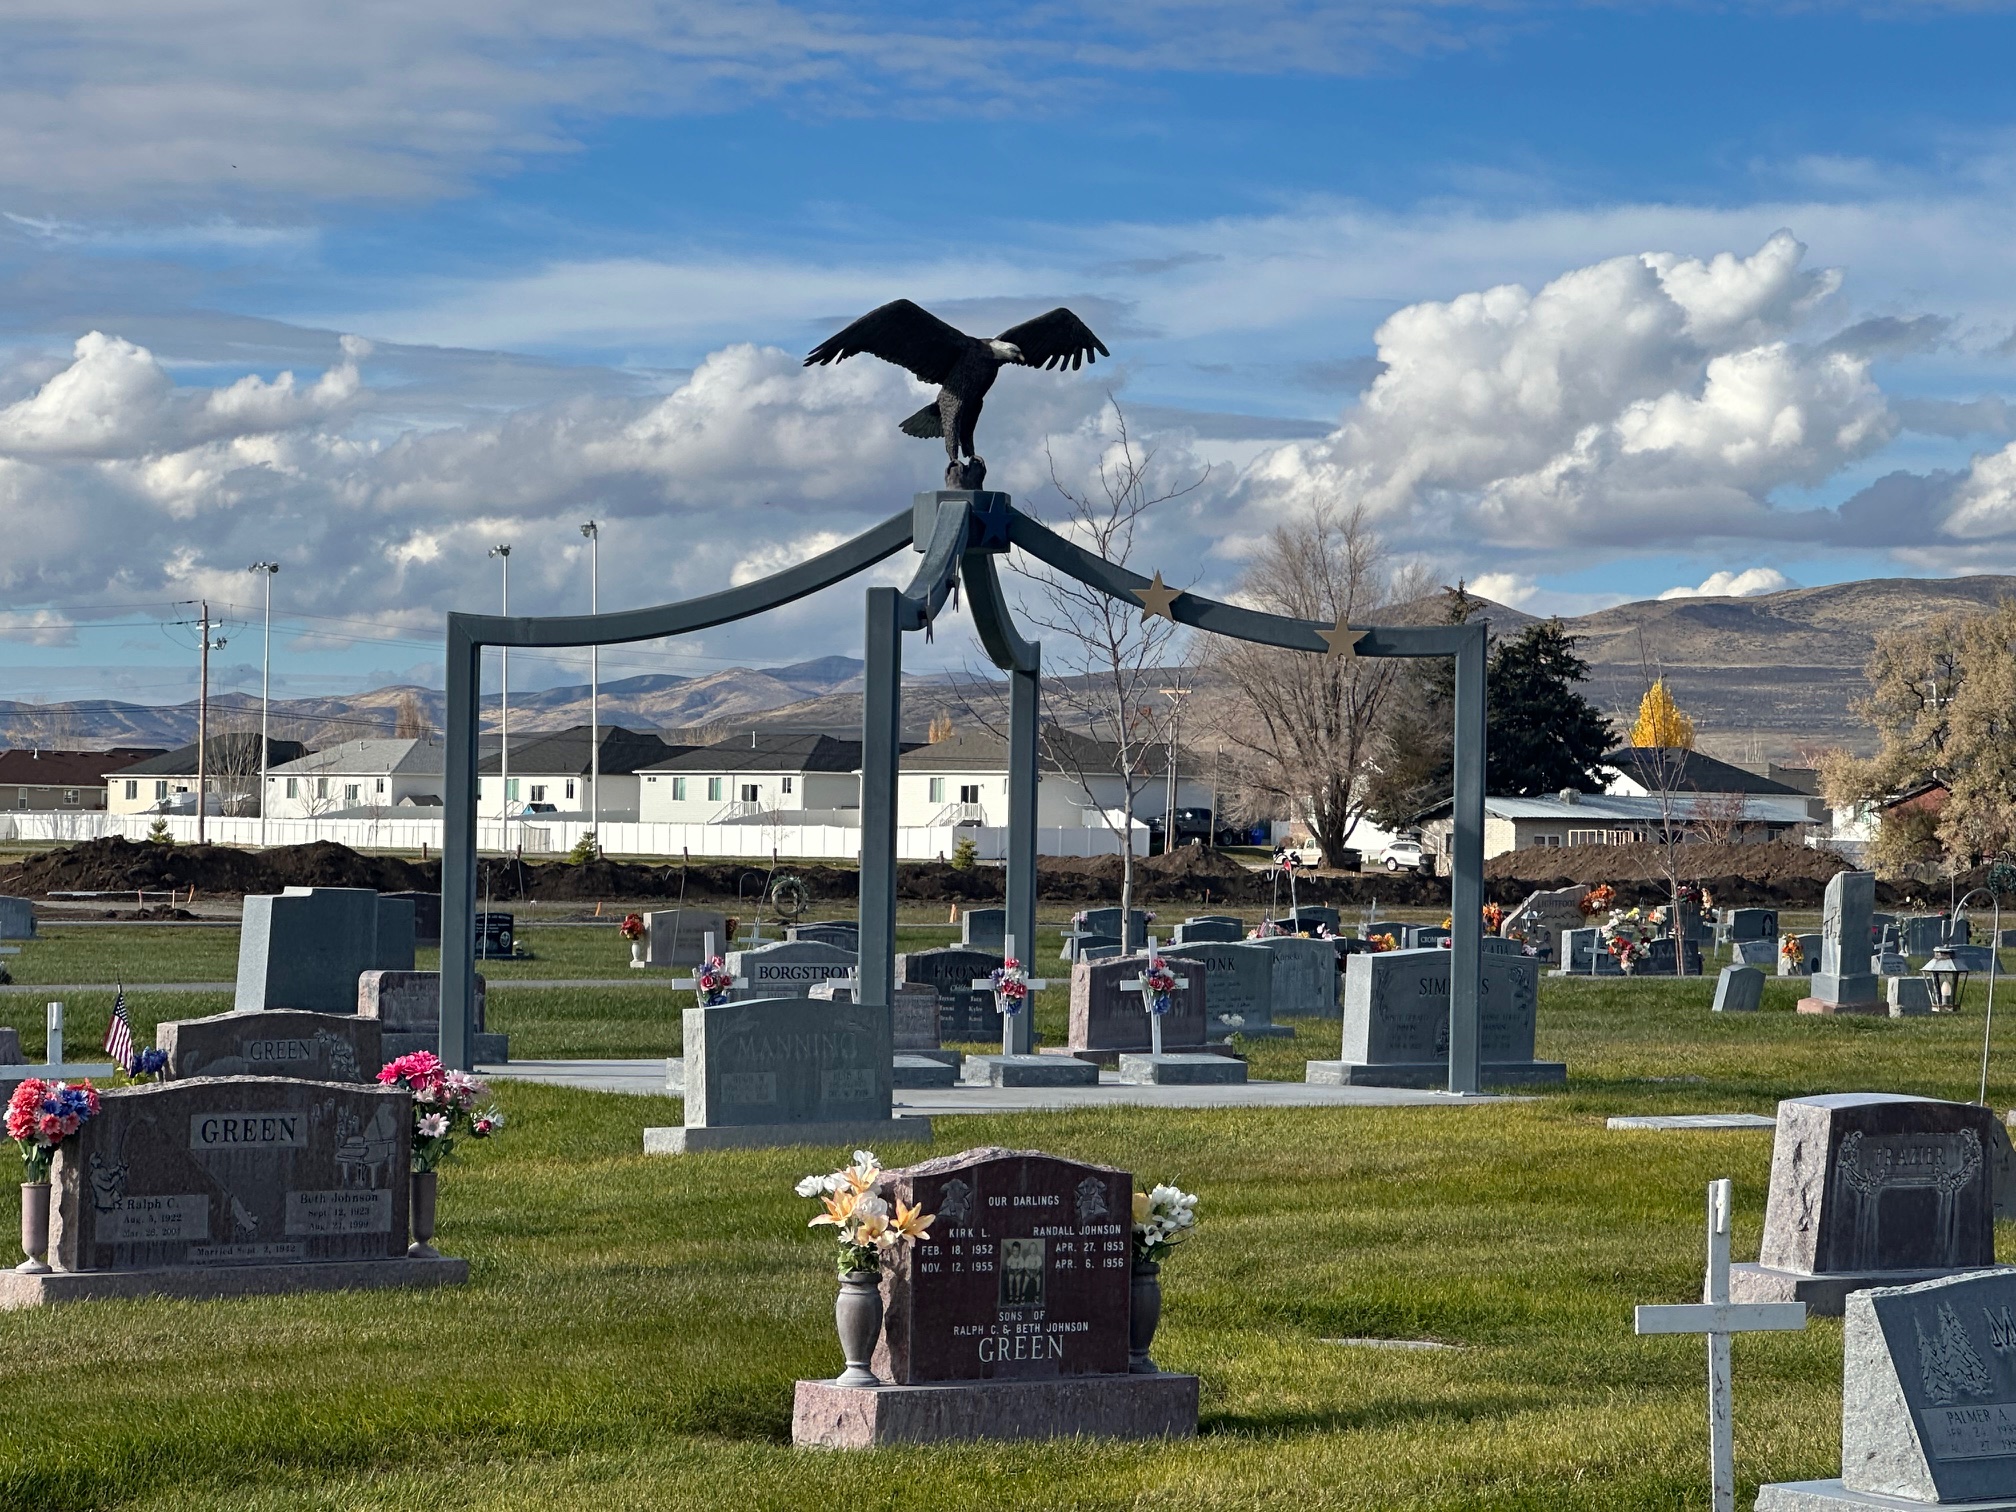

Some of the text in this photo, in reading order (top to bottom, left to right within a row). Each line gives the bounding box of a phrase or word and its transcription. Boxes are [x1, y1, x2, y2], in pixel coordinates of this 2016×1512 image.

[934, 964, 991, 979] FRONK
[250, 1041, 311, 1060] GREEN
[737, 1032, 858, 1062] MANNING
[201, 1117, 298, 1144] GREEN
[1875, 1146, 1946, 1167] FRAZIER
[300, 1192, 378, 1204] Beth Johnson
[988, 1195, 1060, 1206] OUR DARLINGS
[127, 1198, 161, 1211] Ralph
[949, 1228, 991, 1238] KIRK L.
[1033, 1224, 1121, 1236] RANDALL JOHNSON
[921, 1245, 943, 1255] FEB.
[972, 1244, 994, 1255] 1952
[1055, 1242, 1077, 1252] APR.
[1103, 1241, 1124, 1251] 1953
[921, 1262, 943, 1273] NOV.
[971, 1262, 994, 1272] 1955
[1055, 1259, 1077, 1269] APR.
[1103, 1257, 1124, 1268] 1956
[999, 1310, 1046, 1322] SONS OF
[953, 1321, 1089, 1336] RALPH C. & BETH JOHNSON
[978, 1334, 1064, 1363] GREEN
[1946, 1408, 2011, 1425] PALMER A.
